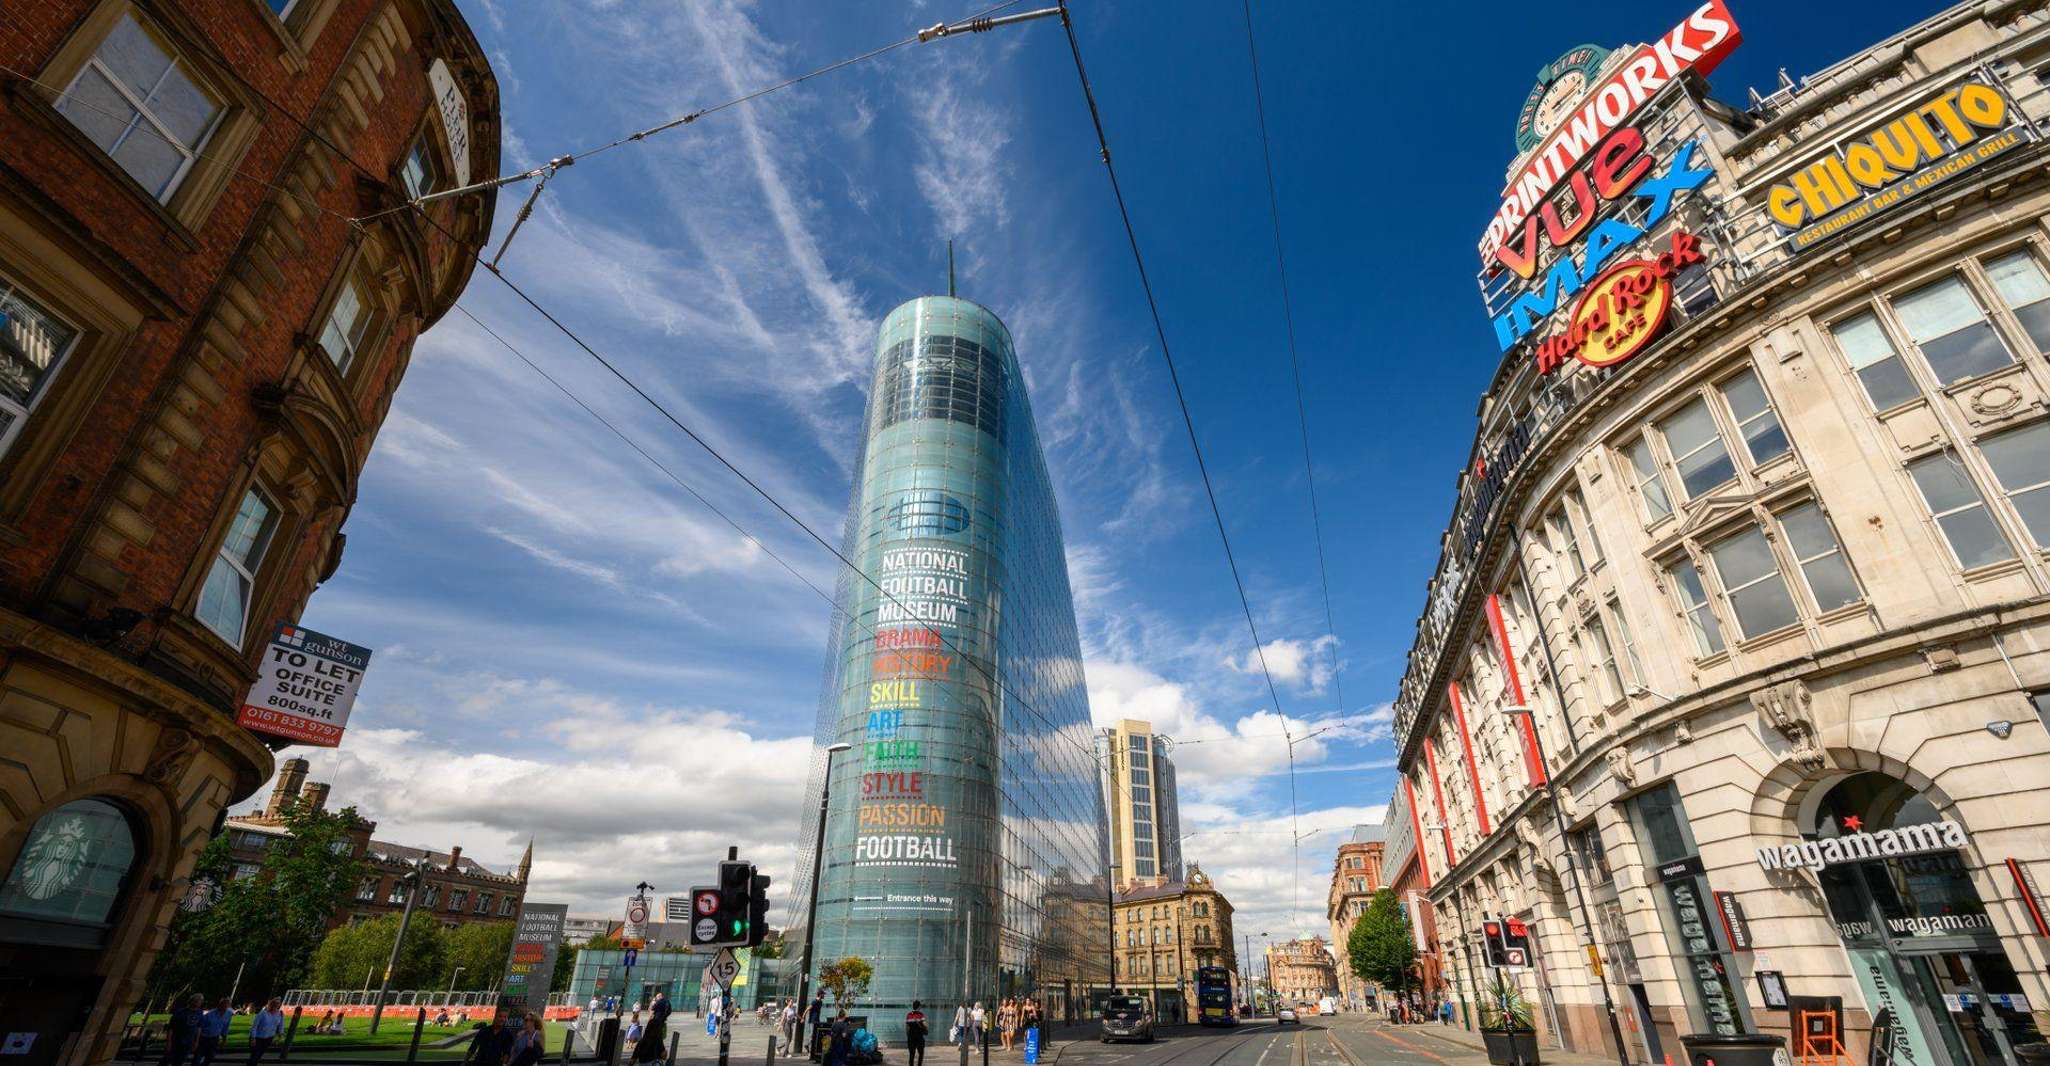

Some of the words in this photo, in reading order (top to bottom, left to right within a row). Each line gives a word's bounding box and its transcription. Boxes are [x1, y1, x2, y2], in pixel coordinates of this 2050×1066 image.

[1489, 2, 1729, 252] PRINTWORKS
[1769, 83, 2007, 228] CHIQUITO
[1796, 205, 1872, 246] RESTAURANT
[1873, 191, 1900, 210] BAR
[1902, 184, 1914, 195] &
[1915, 152, 1976, 188] MEXICAN
[1978, 132, 2020, 158] GRILL
[1494, 139, 1717, 352] IMAX
[1535, 294, 1610, 375] Hard
[1610, 231, 1707, 316] Rock
[1603, 314, 1648, 355] CAFE
[881, 551, 968, 575] NATIONAL
[879, 576, 968, 600] FOOTBALL
[878, 602, 957, 623] MUSEUM
[876, 628, 942, 648] DRAMA
[272, 647, 307, 667] TO
[315, 658, 360, 683] LET
[304, 641, 362, 666] gunson
[873, 655, 952, 673] HISTORY
[276, 668, 345, 696] OFFICE
[276, 682, 336, 706] SUITE
[871, 682, 921, 703] SKILL
[267, 695, 334, 720] 800sq.ft
[247, 707, 278, 723] 0161
[280, 716, 306, 730] 833
[308, 722, 340, 737] 9797
[867, 709, 905, 732] ART
[863, 740, 920, 763] FAITH
[862, 771, 923, 795] STYLE
[859, 803, 946, 827] PASSION
[855, 835, 958, 862] FOOTBALL
[1755, 819, 1969, 872] wagamama
[887, 893, 922, 903] Entrance
[923, 893, 938, 903] this
[939, 896, 954, 905] way
[521, 923, 558, 932] FOOTBALL
[523, 912, 560, 921] NATIONAL
[1721, 895, 1747, 948] wagamama
[519, 933, 553, 941] MUSEUM
